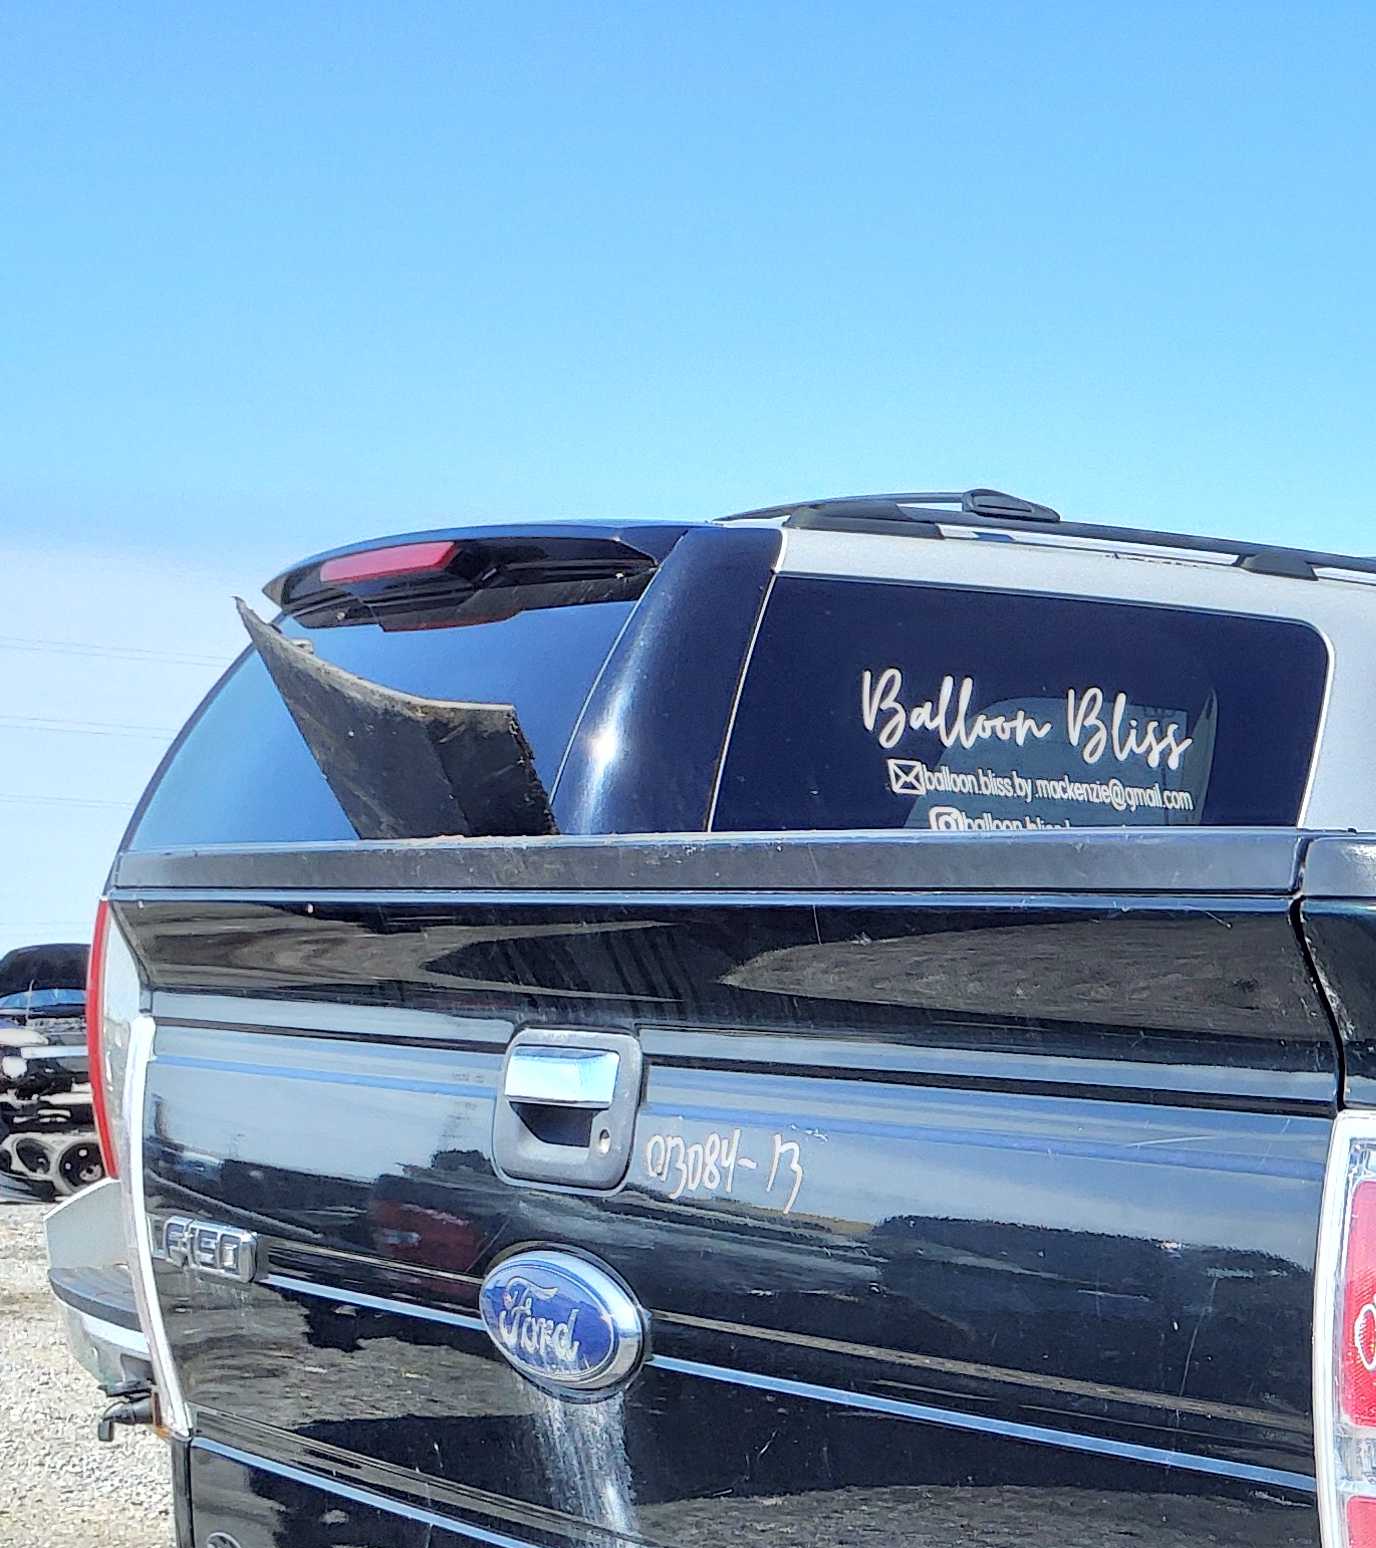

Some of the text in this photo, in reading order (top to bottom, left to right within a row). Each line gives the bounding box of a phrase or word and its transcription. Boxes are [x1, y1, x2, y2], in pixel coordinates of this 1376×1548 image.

[860, 666, 1193, 769] Balloon Bliss
[645, 1127, 804, 1215] 013084-13
[498, 1274, 581, 1362] Ford
